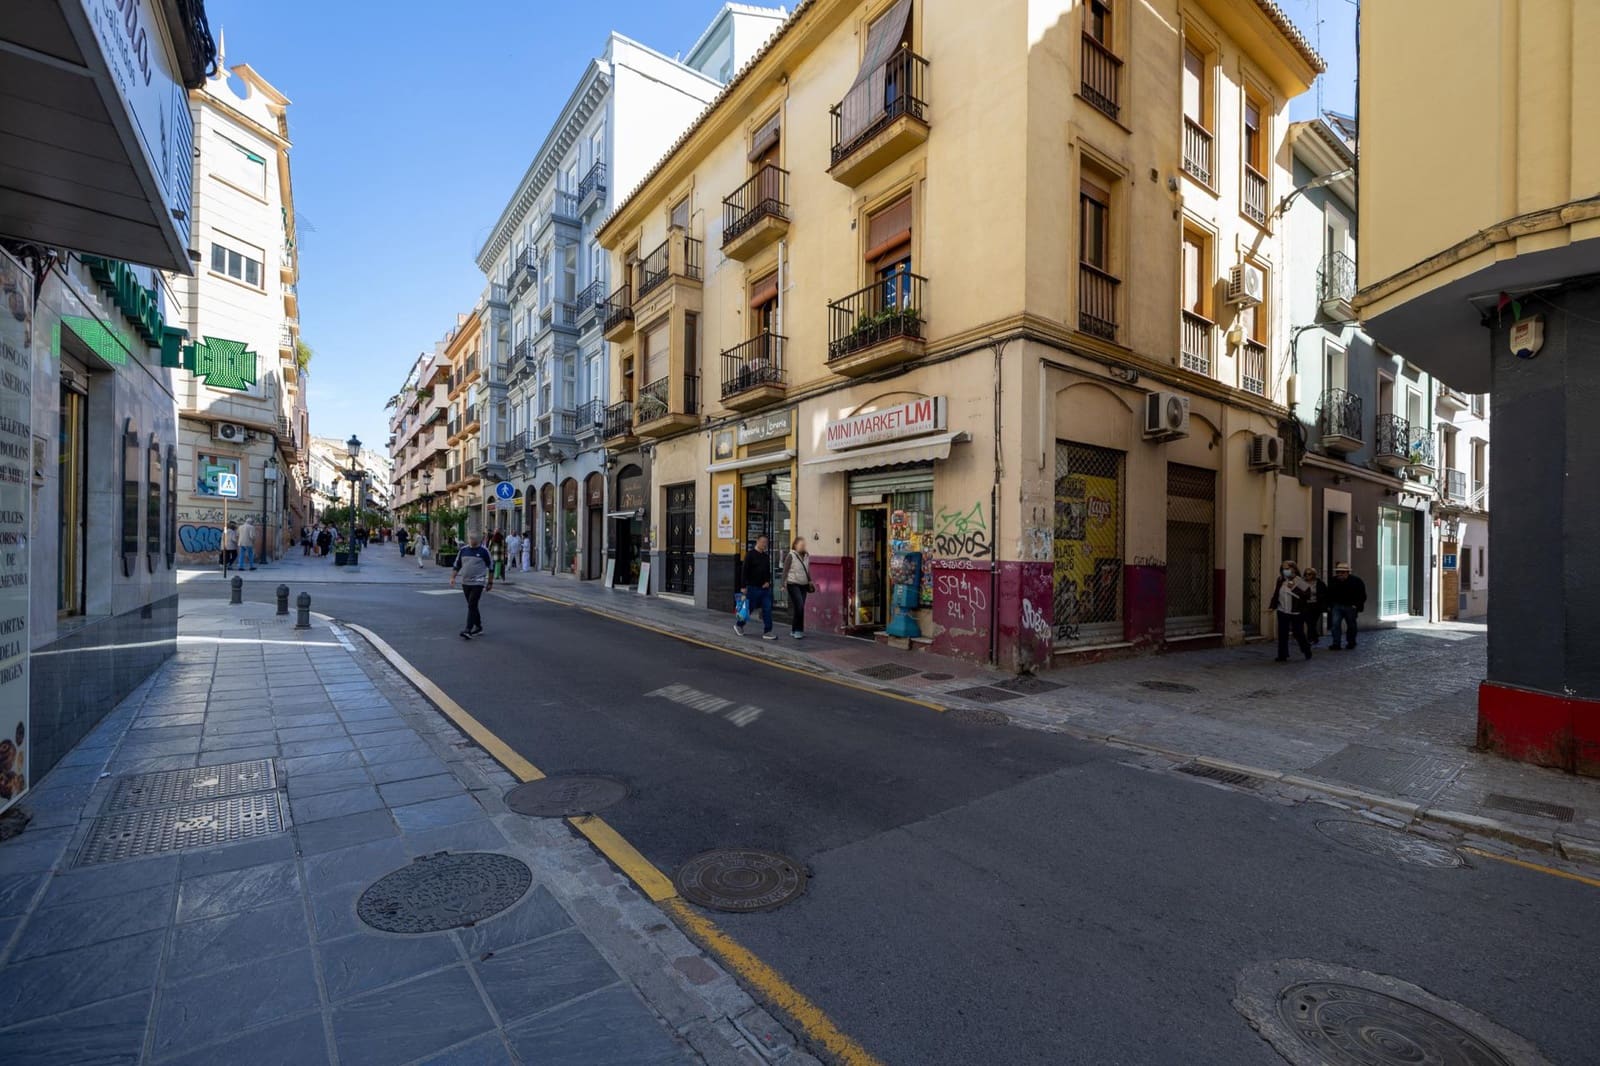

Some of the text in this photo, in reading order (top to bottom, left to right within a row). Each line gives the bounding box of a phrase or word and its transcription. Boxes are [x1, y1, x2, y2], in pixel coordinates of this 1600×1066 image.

[827, 422, 852, 441] MINI
[853, 410, 902, 436] MARKET
[905, 400, 931, 425] LM
